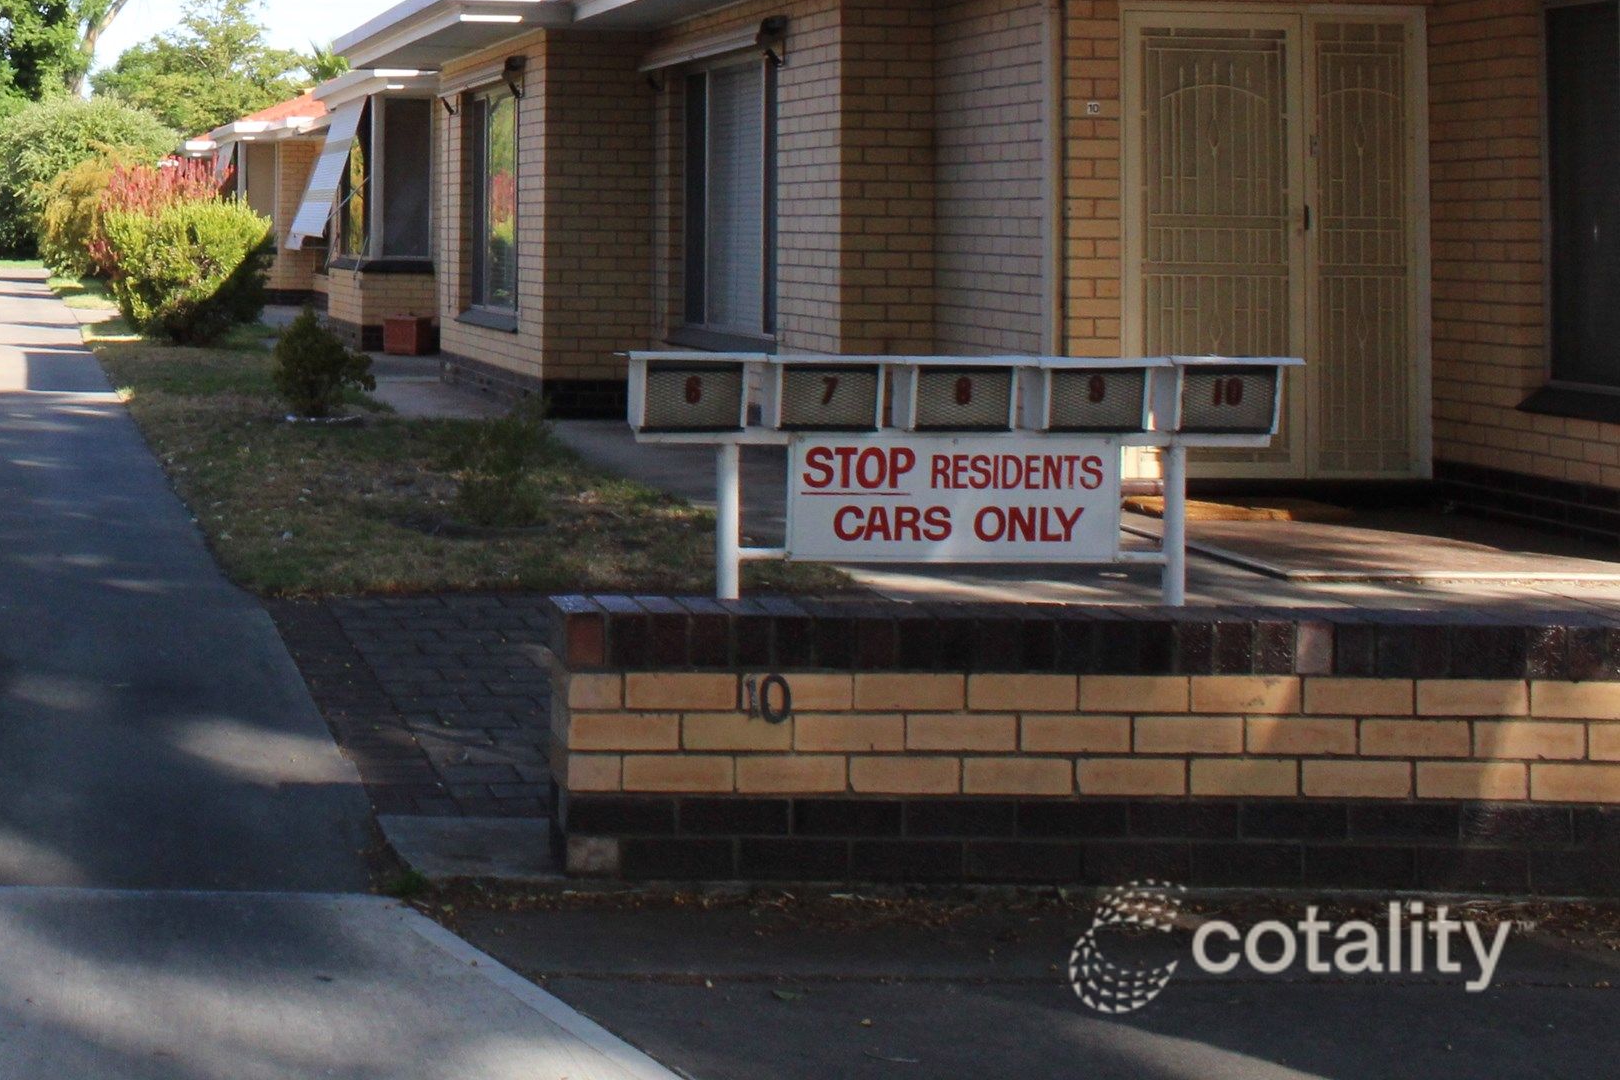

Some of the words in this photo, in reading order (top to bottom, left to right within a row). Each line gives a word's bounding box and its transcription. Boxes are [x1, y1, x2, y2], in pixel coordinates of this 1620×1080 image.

[1087, 103, 1099, 113] 10
[685, 376, 701, 404] 6
[822, 376, 838, 405] 7
[956, 376, 972, 405] 8
[1089, 375, 1105, 403] 9
[1213, 377, 1253, 406] 10
[802, 446, 916, 489] STOP
[931, 454, 1104, 490] RESIDENTS
[833, 505, 952, 542] CARS
[973, 506, 1084, 542] ONLY
[746, 674, 791, 723] 10
